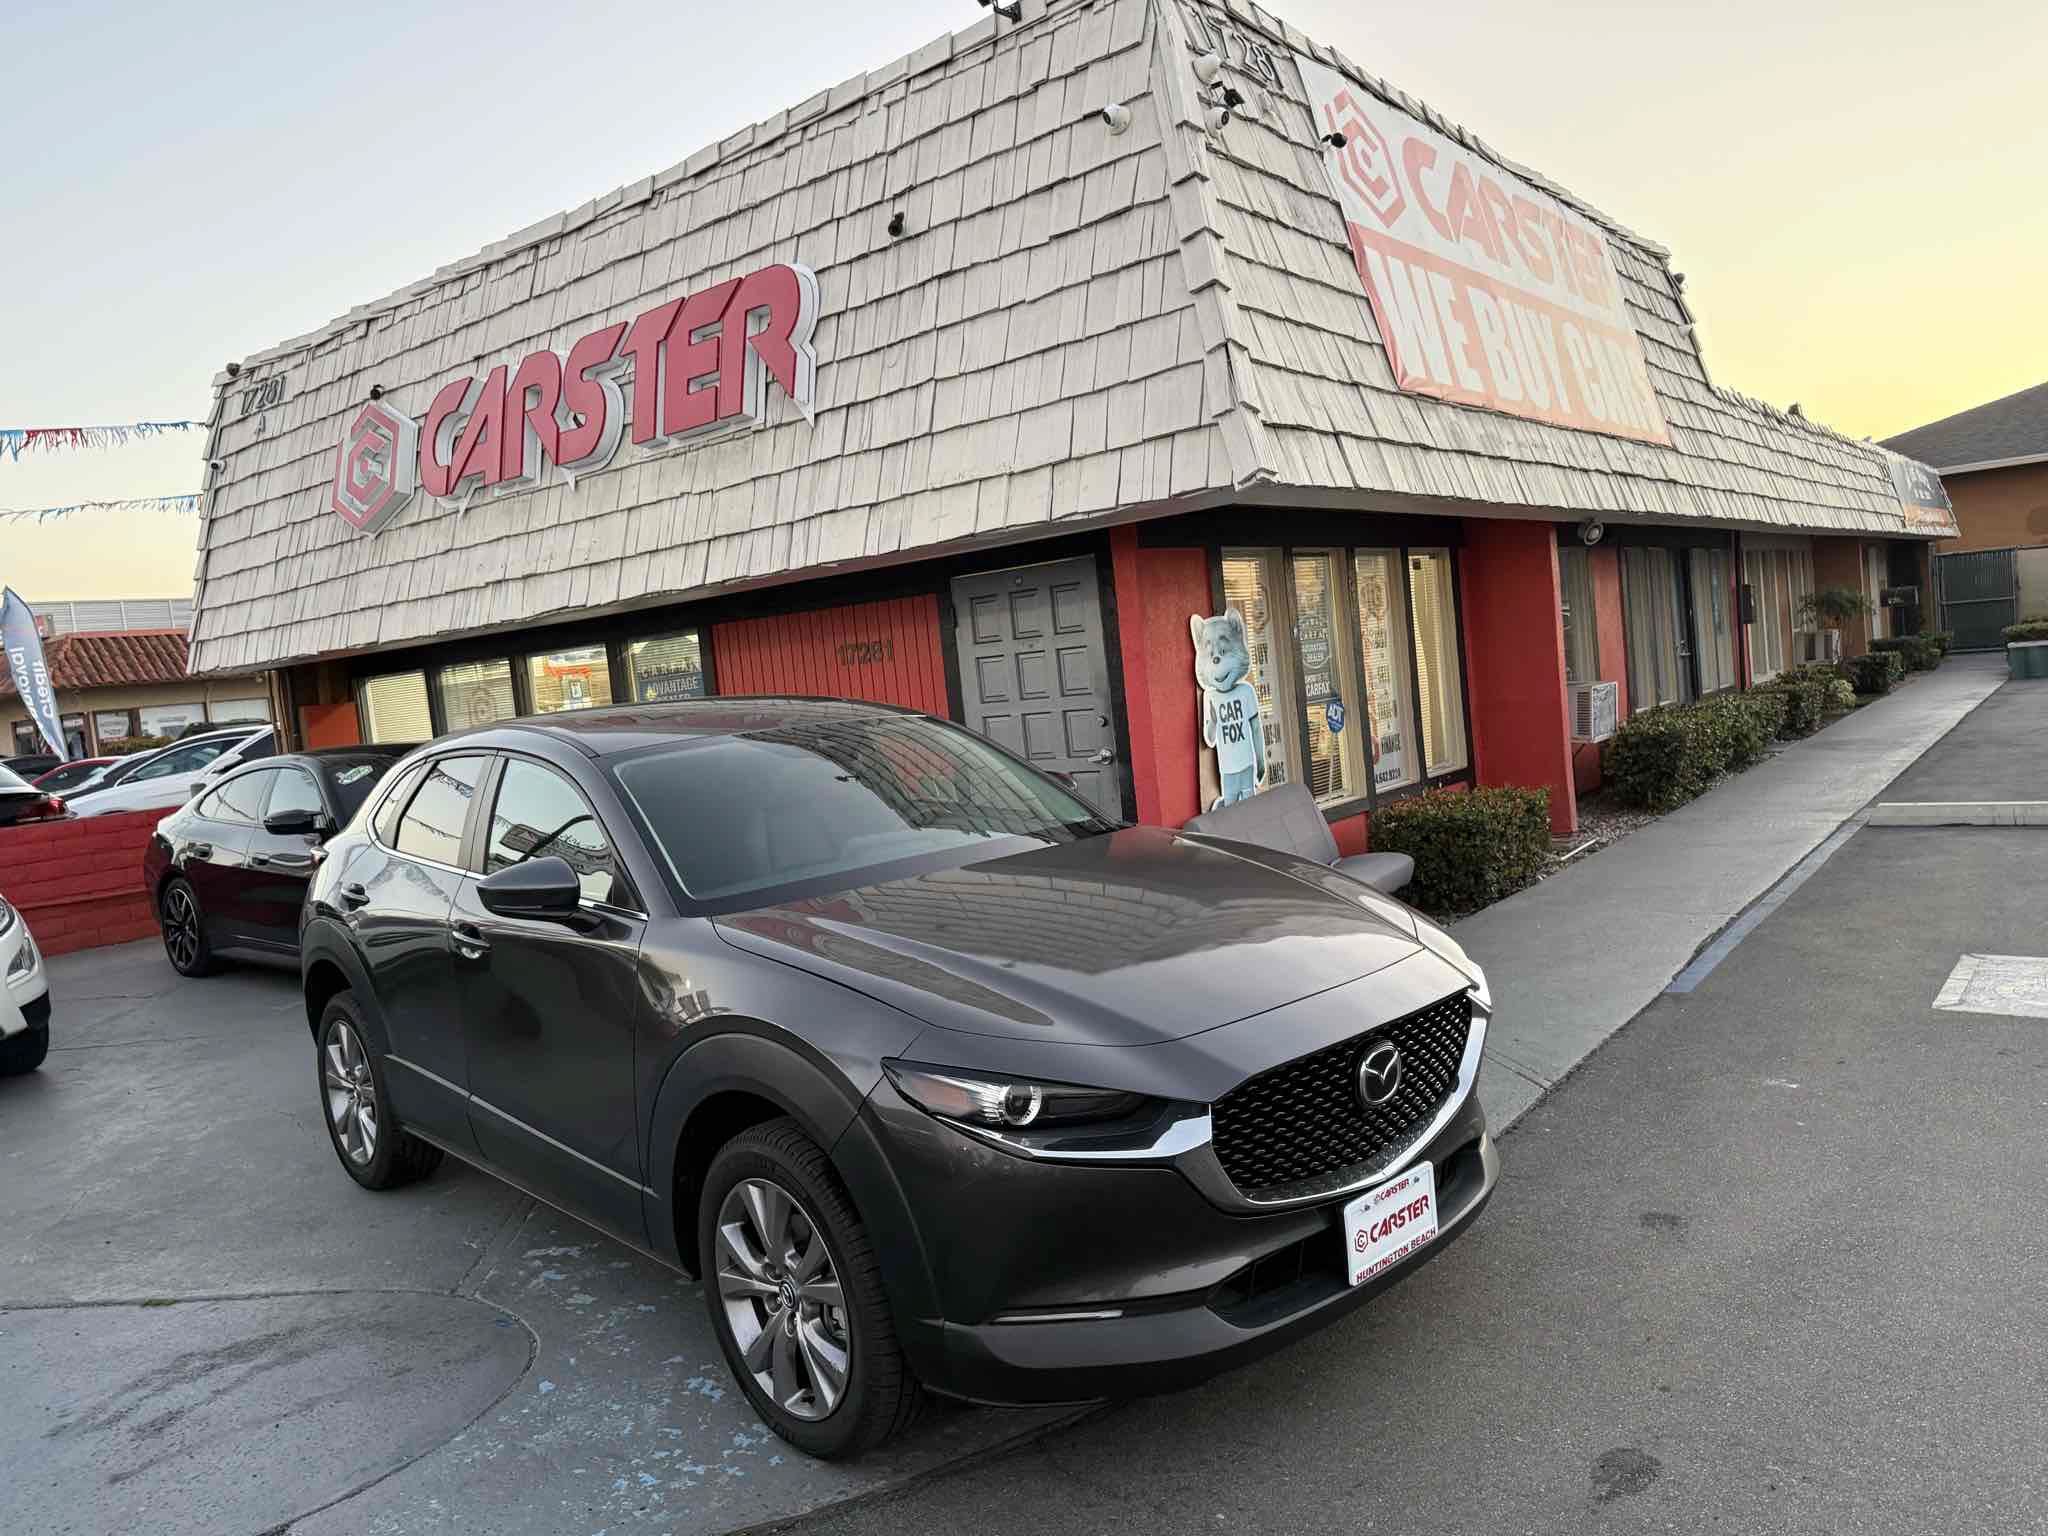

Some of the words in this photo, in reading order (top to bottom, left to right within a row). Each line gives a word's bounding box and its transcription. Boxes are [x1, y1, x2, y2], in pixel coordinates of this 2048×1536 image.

[1402, 136, 1614, 304] CARSTER
[1365, 246, 1486, 391] WE
[1467, 285, 1572, 415] BUY
[241, 375, 286, 416] 17281
[419, 263, 812, 498] CARSTER
[1305, 681, 1330, 698] CARFAX
[1219, 699, 1243, 723] CAR
[1328, 703, 1344, 722] ADT
[1222, 721, 1245, 744] FOX
[1380, 1178, 1409, 1201] CARSTER
[1369, 1194, 1430, 1244] CARSTER
[1356, 1244, 1409, 1283] HUNTINGTON
[1410, 1227, 1437, 1249] BEACH
